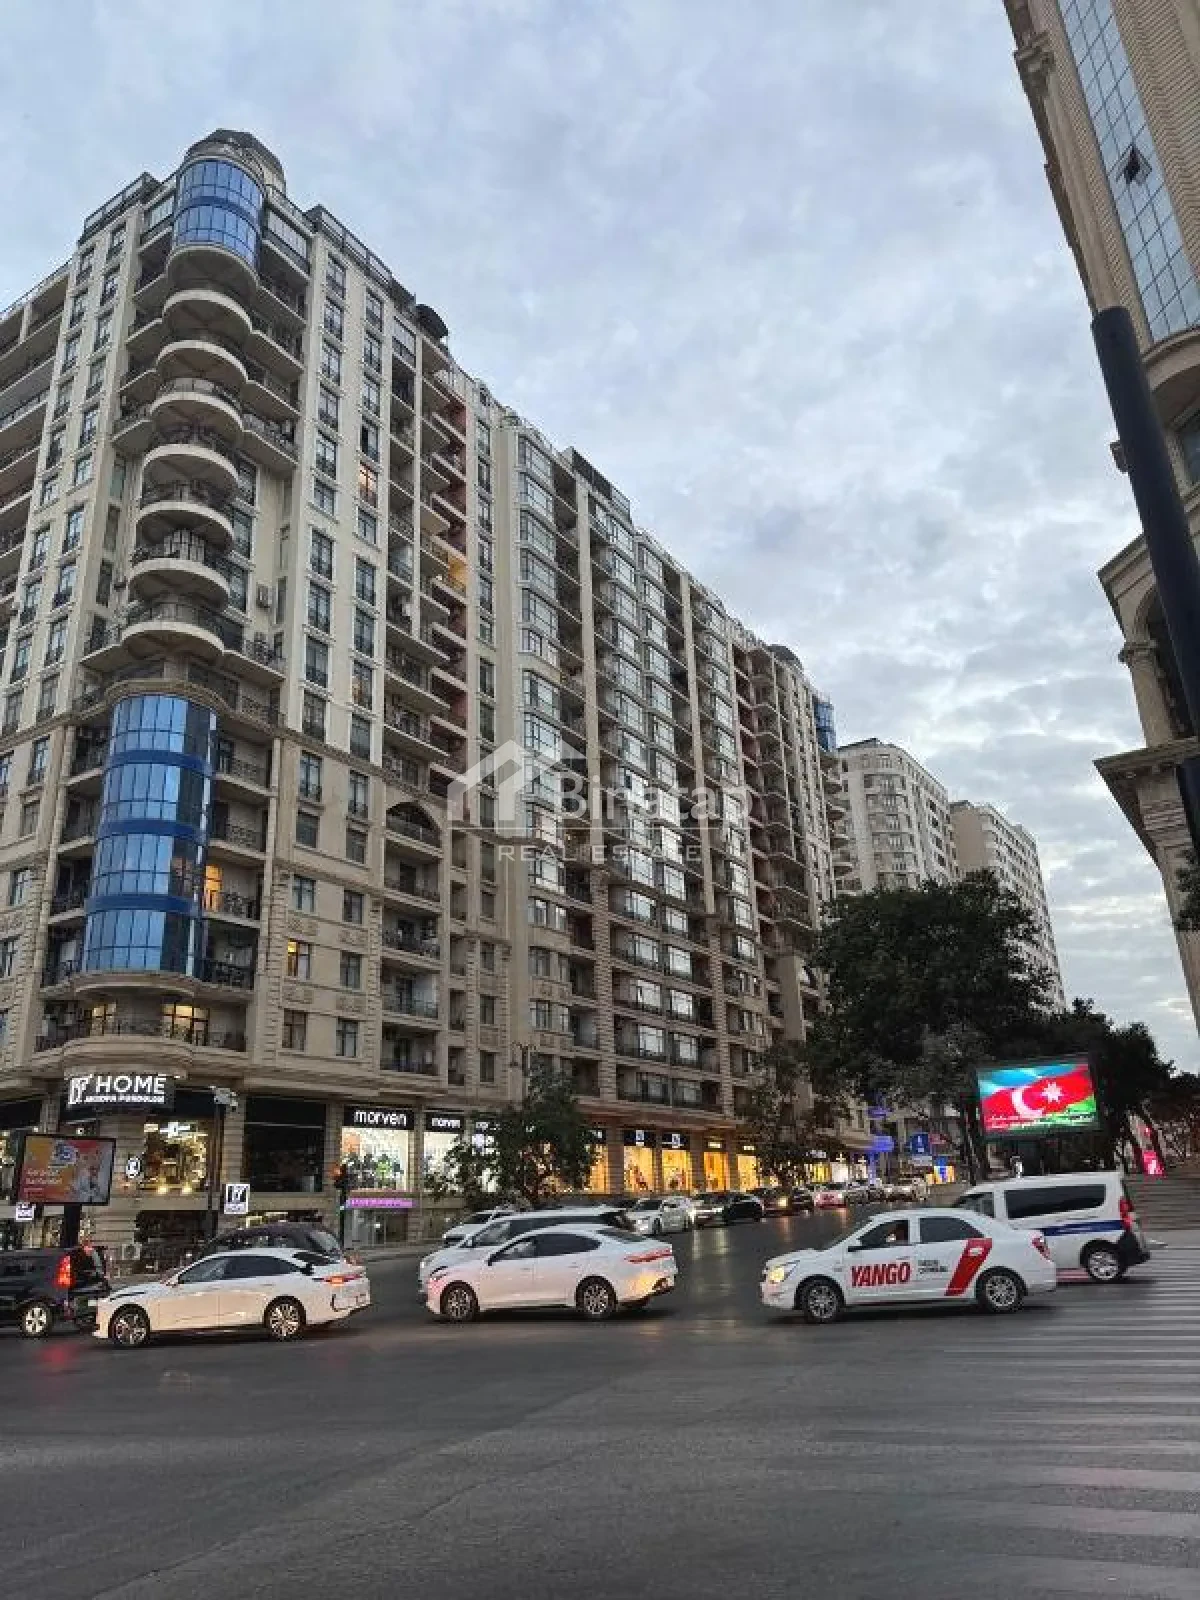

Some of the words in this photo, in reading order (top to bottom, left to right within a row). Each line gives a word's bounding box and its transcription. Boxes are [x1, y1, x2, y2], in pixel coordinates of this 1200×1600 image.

[95, 1076, 166, 1094] HOME
[354, 1111, 407, 1126] morven
[851, 1262, 911, 1286] YANGO
